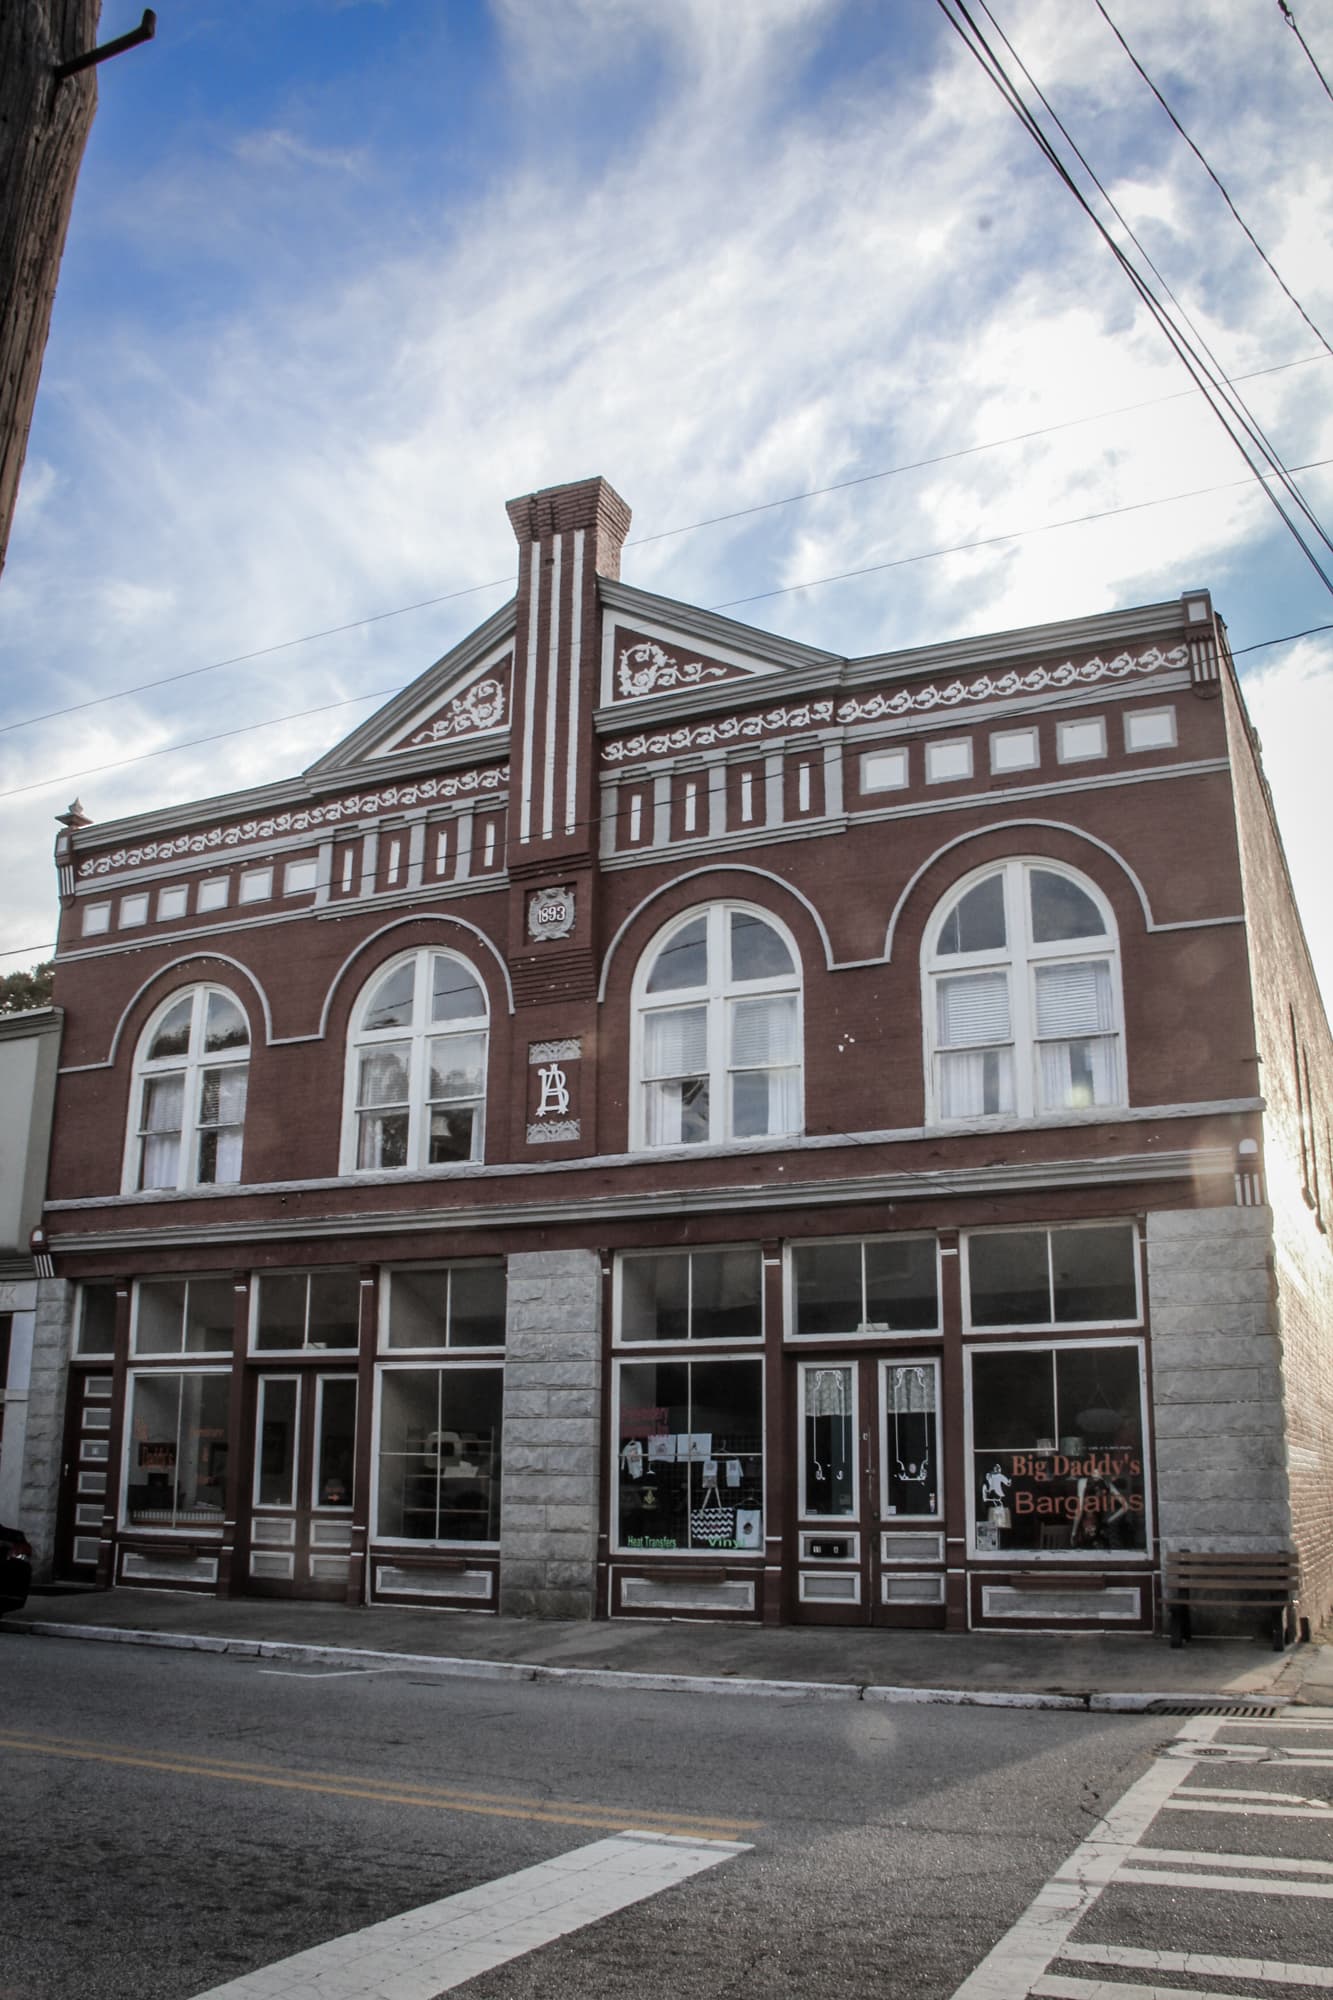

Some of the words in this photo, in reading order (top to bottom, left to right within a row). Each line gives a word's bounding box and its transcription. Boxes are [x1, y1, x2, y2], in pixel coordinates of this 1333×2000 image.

[538, 905, 566, 924] 1893
[1012, 1455, 1049, 1482] Big
[1053, 1453, 1141, 1482] Daddy's
[1015, 1489, 1144, 1520] Bargains
[627, 1536, 641, 1548] Heat
[644, 1535, 676, 1549] Transfers
